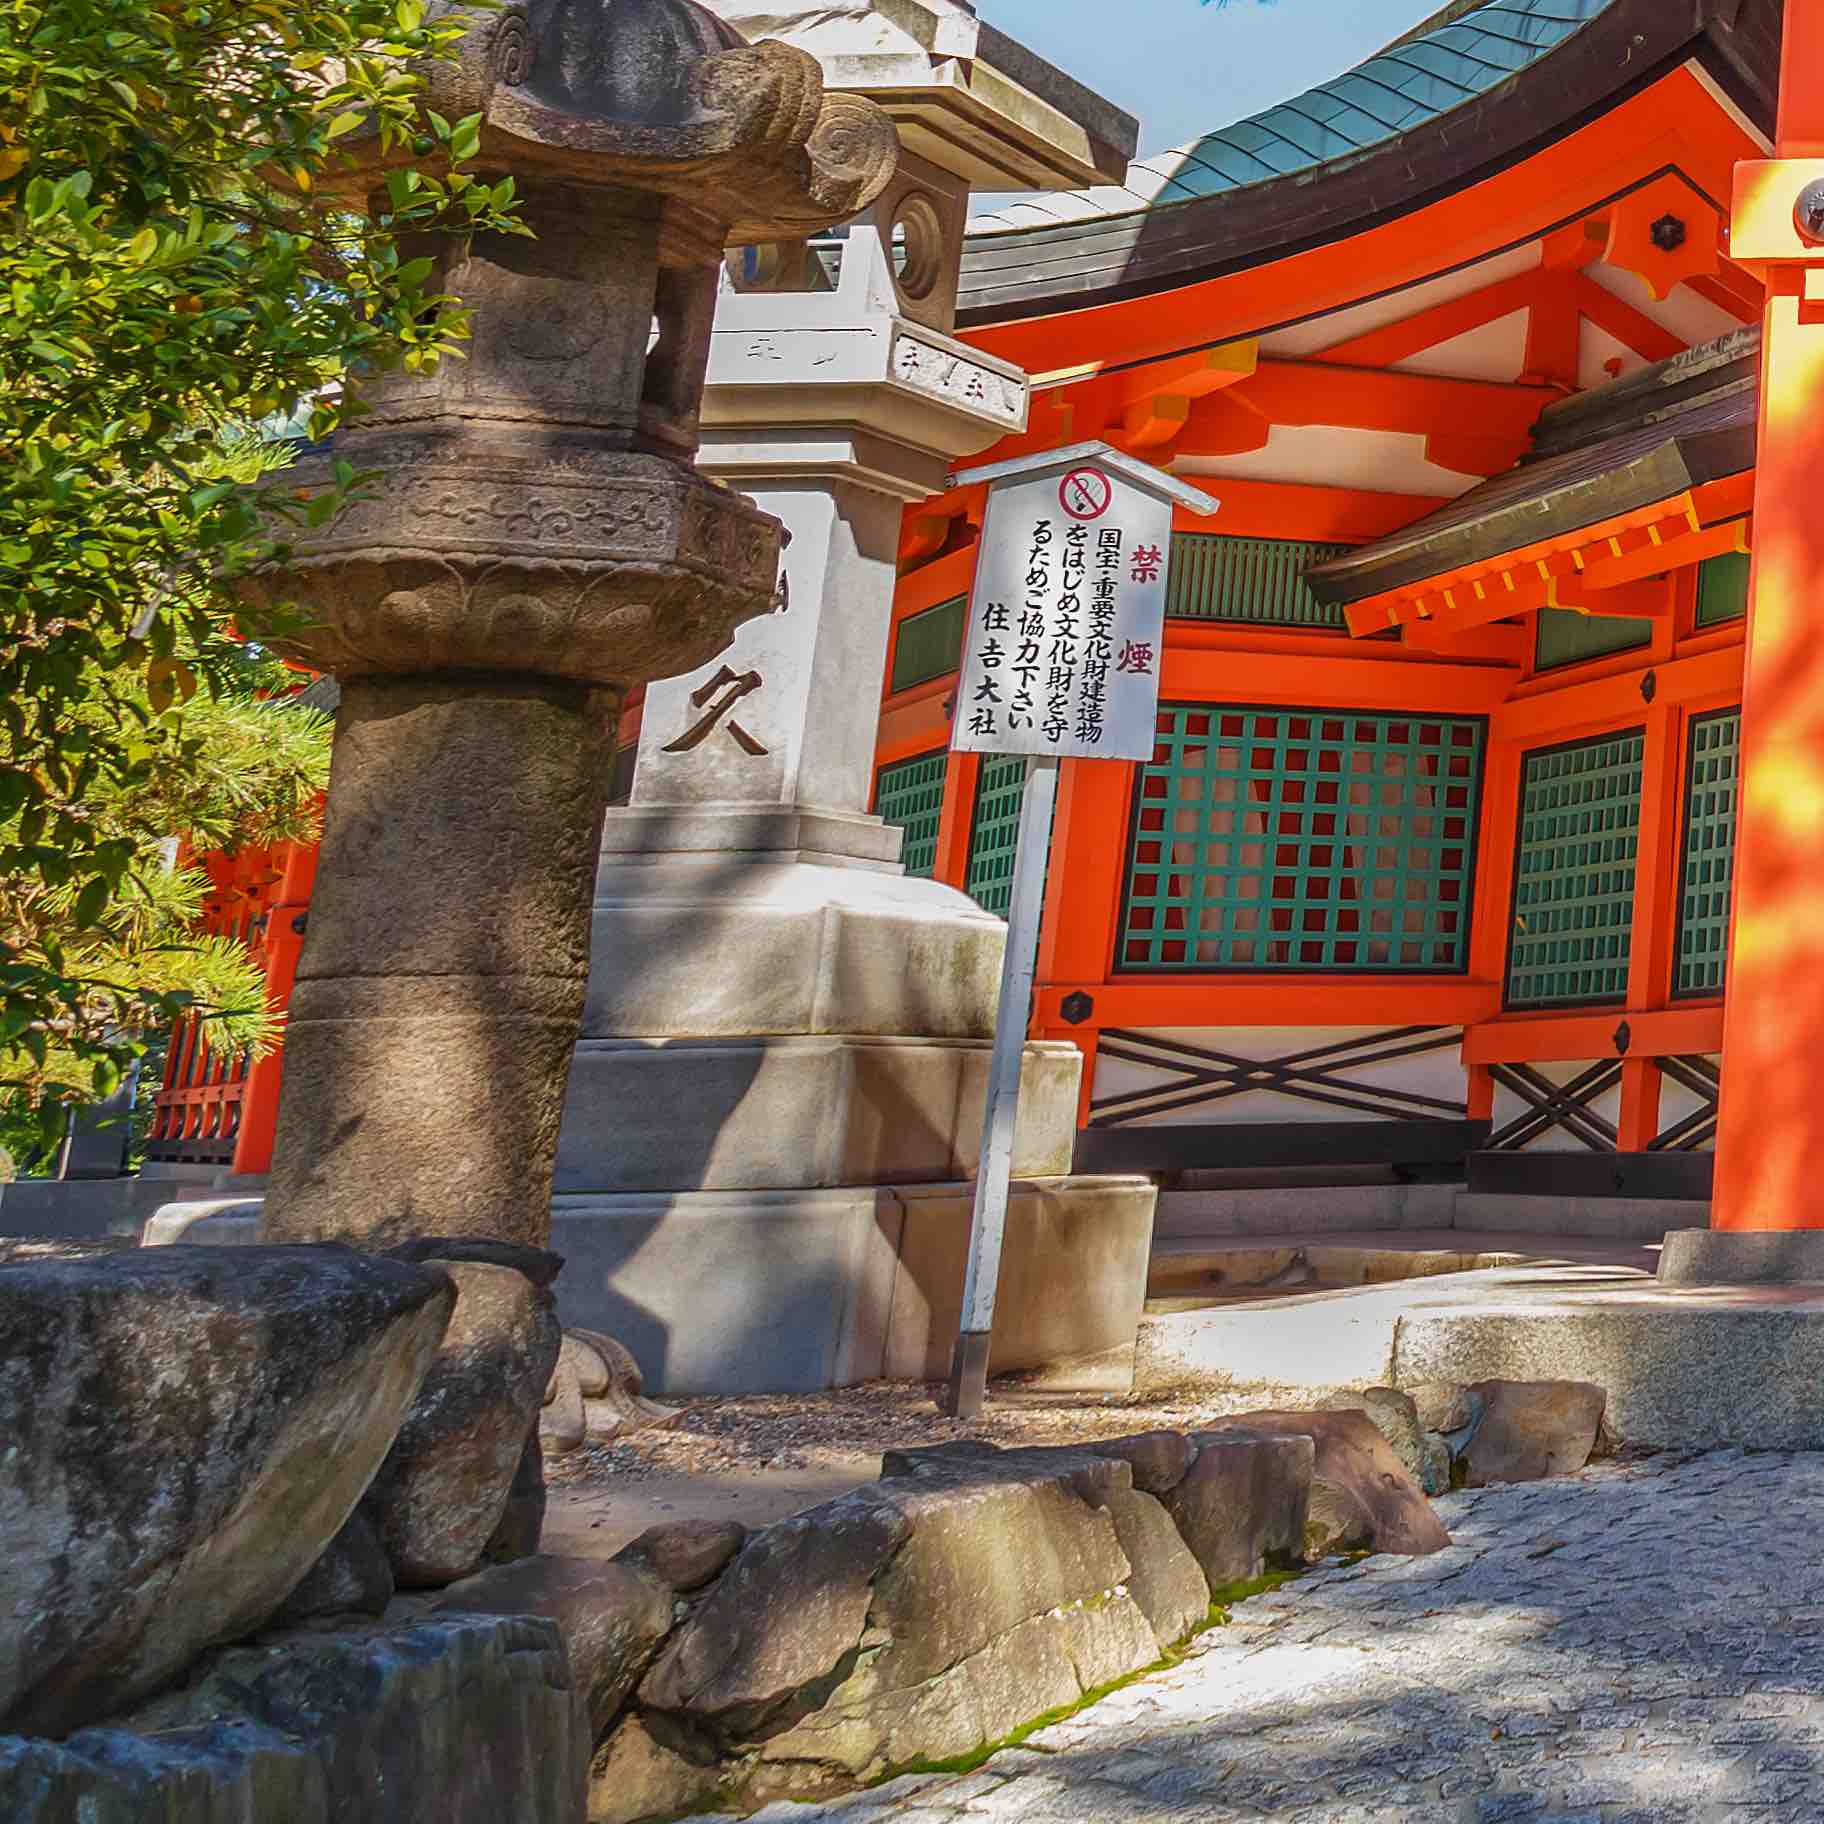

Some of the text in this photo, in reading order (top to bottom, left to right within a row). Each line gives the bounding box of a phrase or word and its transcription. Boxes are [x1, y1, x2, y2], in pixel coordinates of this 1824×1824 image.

[968, 602, 1011, 736] 住吉大社
[1008, 520, 1052, 730] るためご協力下さい
[1041, 524, 1089, 744] をはじめ文化財を守
[1074, 528, 1122, 744] 国宝・重要文化財建造物
[1116, 544, 1163, 675] 禁煙
